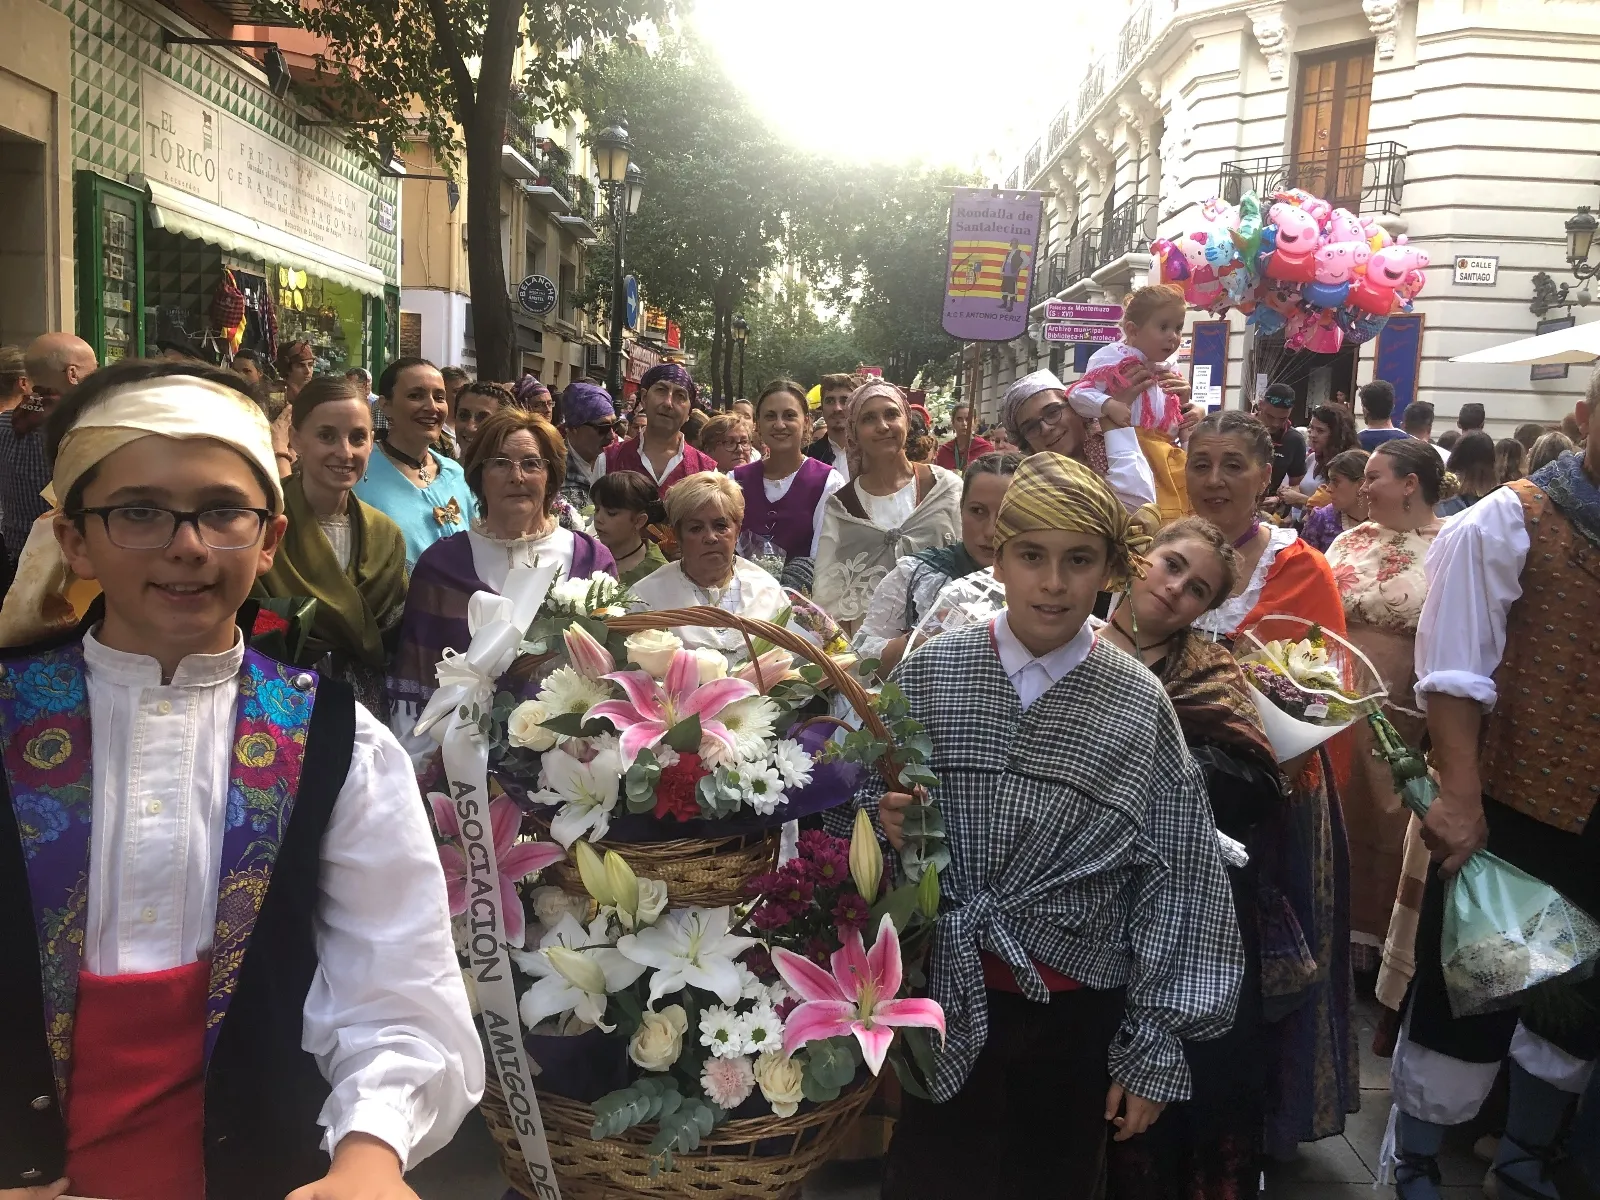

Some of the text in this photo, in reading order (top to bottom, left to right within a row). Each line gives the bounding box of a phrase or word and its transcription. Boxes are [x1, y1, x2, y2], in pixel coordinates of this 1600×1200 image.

[161, 110, 176, 135] EL
[145, 120, 216, 182] TORICO
[240, 142, 289, 178] FRUTAS
[956, 207, 1034, 222] Rondalla de
[955, 221, 1032, 236] Santalecina
[1459, 272, 1491, 282] SANTIAGO
[1470, 261, 1492, 269] CALLE
[519, 276, 555, 302] BELANCHE
[965, 312, 998, 320] ANTONIO
[1075, 304, 1110, 313] Montemuzo
[452, 780, 507, 983] ASOCIACIÓN
[485, 1009, 536, 1137] AMIGOS
[528, 1161, 558, 1200] DE
